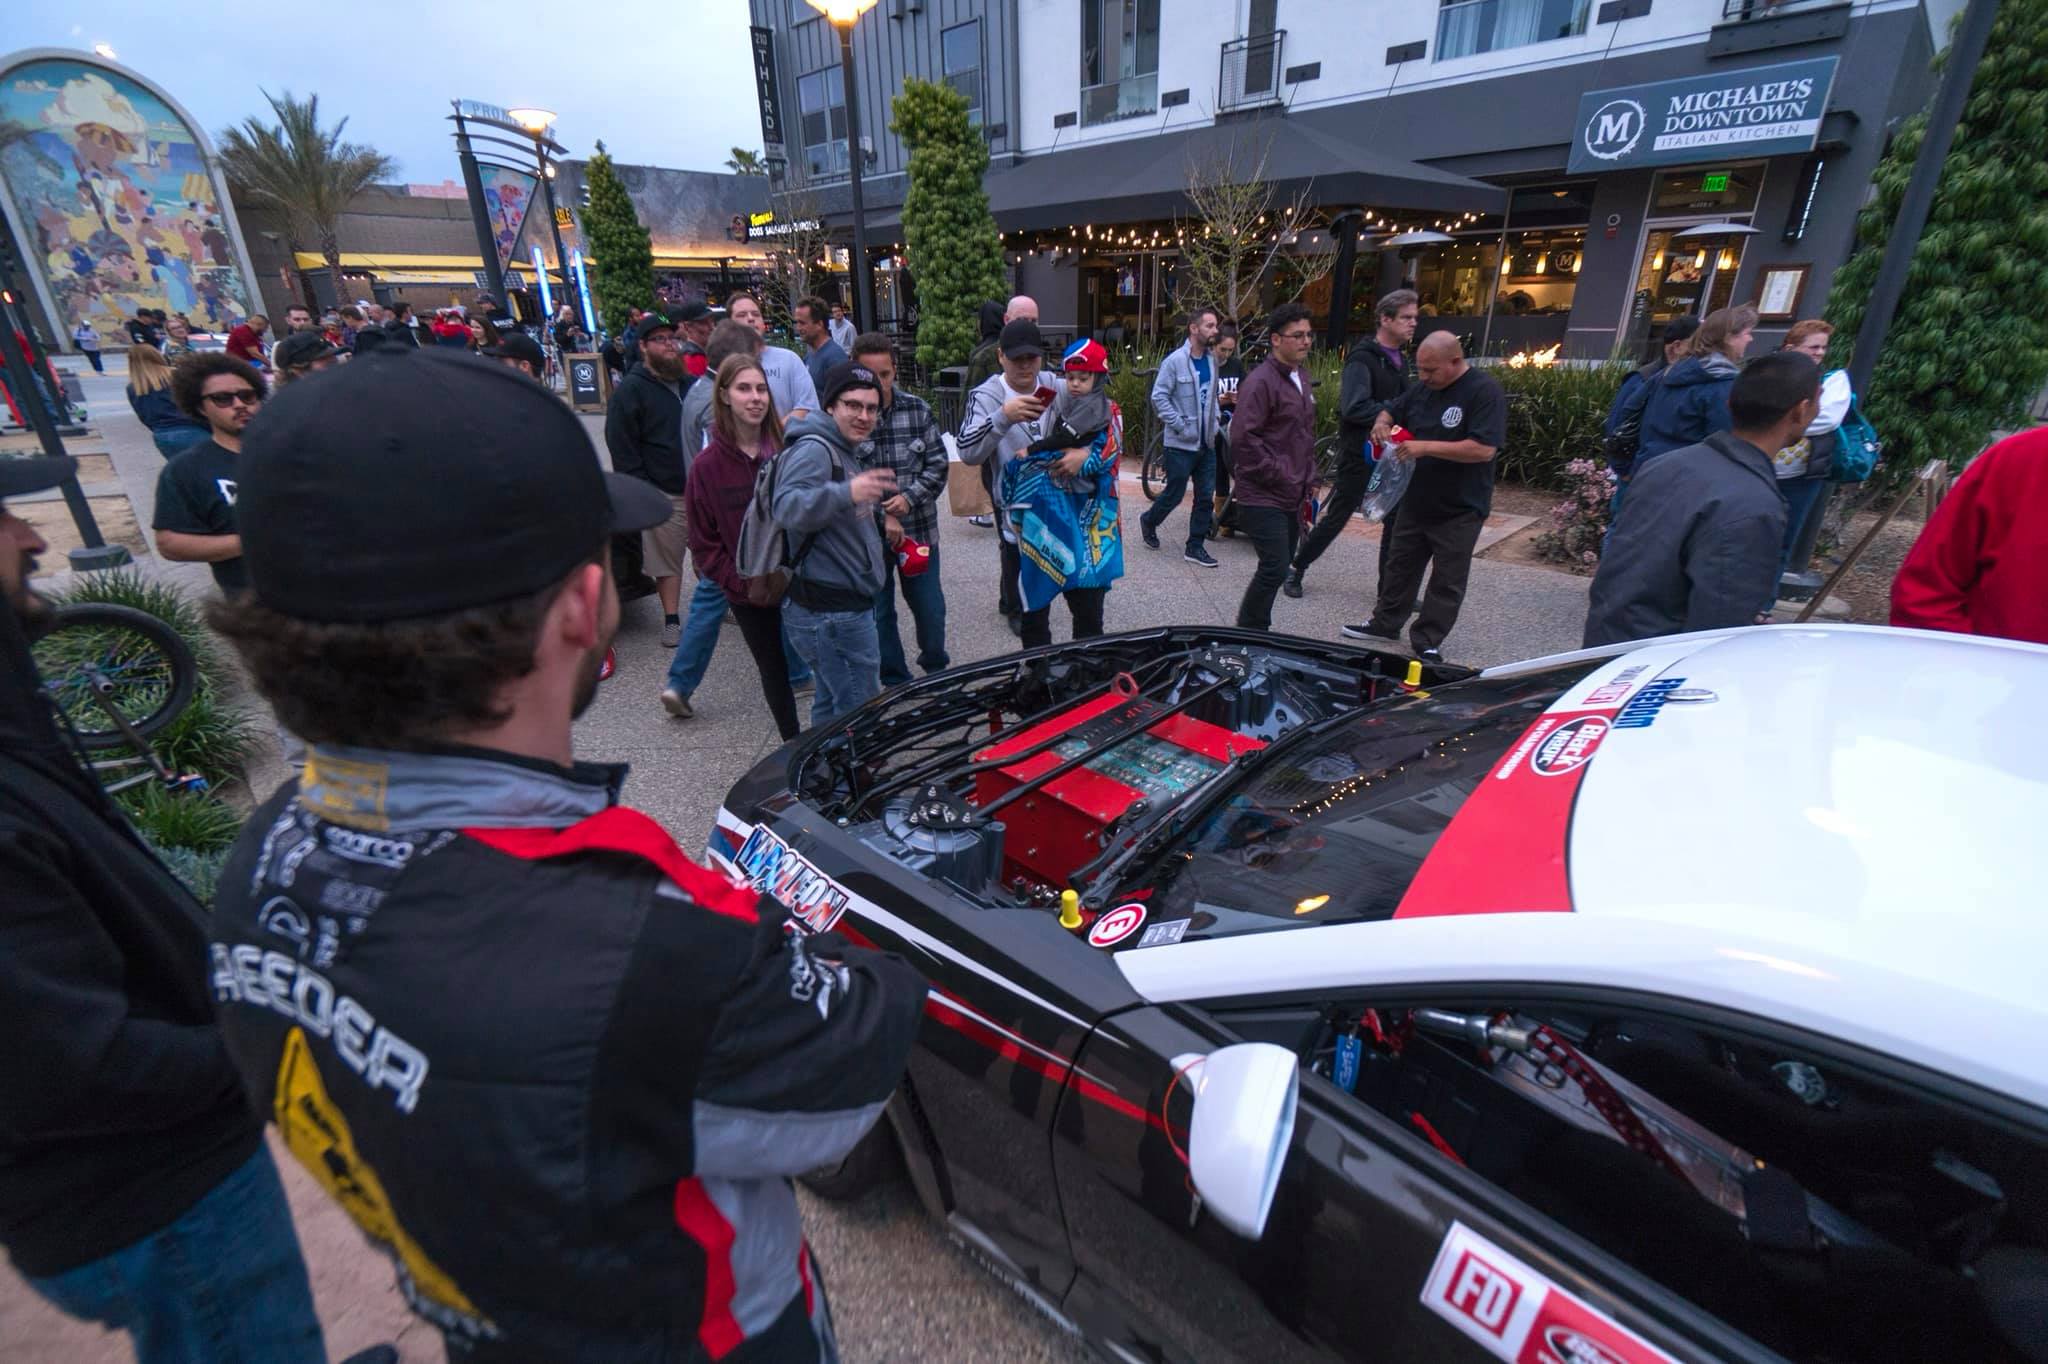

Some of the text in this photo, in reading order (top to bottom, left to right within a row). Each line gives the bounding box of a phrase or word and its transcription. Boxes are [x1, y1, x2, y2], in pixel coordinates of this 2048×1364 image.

[758, 48, 775, 129] THIRD
[1668, 78, 1813, 115] MICHAEL'S
[1595, 111, 1630, 145] M
[1661, 125, 1800, 148] ITALIAN KITCHEN
[1663, 101, 1808, 133] DOWNTOWN
[1612, 677, 1688, 729] FREEDOM
[1556, 723, 1607, 767] Black
[736, 825, 848, 934] NAPOLEON
[1102, 916, 1132, 934] E
[1451, 1257, 1513, 1328] FD
